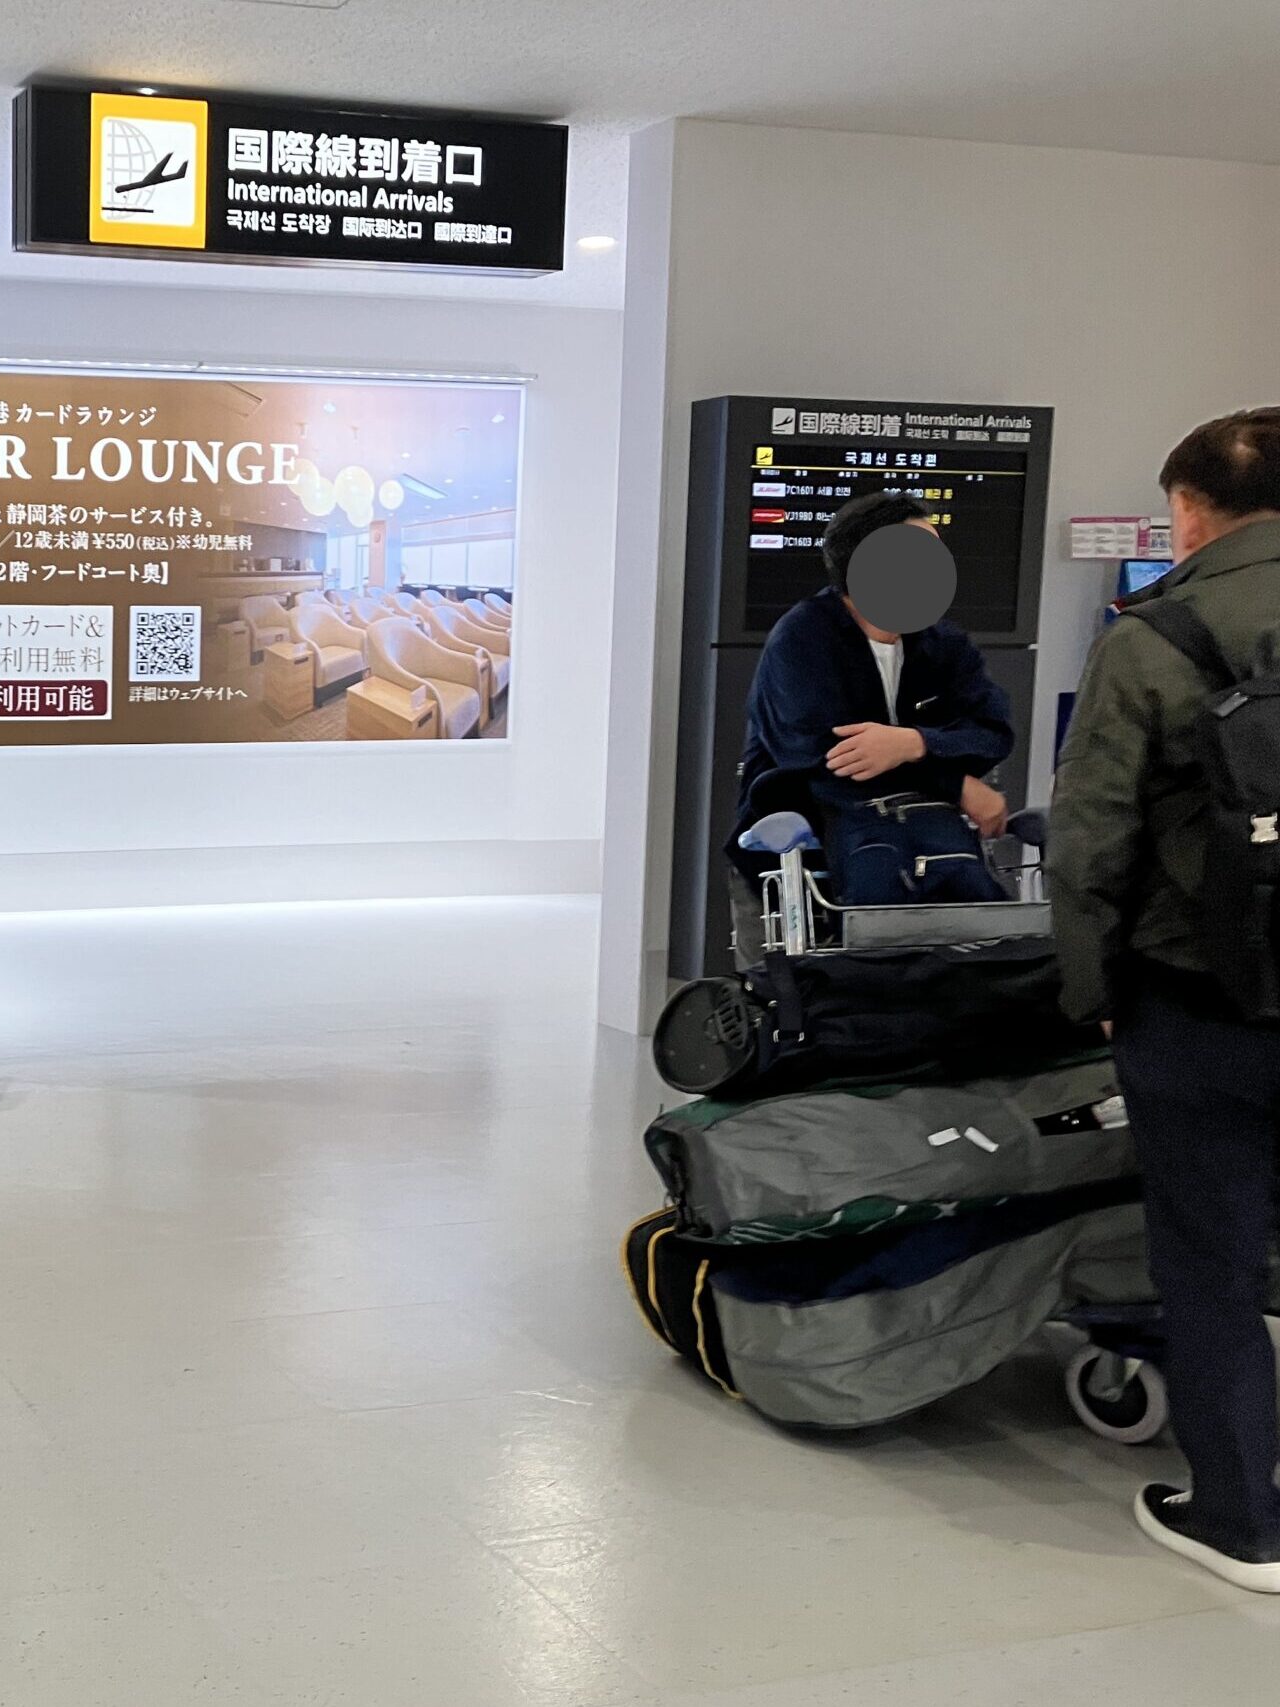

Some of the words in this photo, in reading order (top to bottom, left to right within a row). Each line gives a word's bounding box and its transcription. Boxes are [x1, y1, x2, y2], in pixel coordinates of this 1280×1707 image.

[227, 127, 482, 186] 国際線到着口
[227, 178, 368, 209] International
[372, 187, 454, 213] Arrivals
[226, 209, 276, 232] 국제선
[280, 212, 331, 235] 도착장
[342, 216, 422, 240] 国际到达口
[16, 403, 157, 427] カードラウンジ
[799, 411, 902, 438] 国際線到着
[905, 412, 984, 428] International
[985, 414, 1032, 430] Arrivals
[51, 436, 301, 486] LOUNGE
[845, 451, 887, 466] 국제선
[786, 485, 814, 495] 7C1601
[784, 536, 812, 547] 7C1603
[128, 686, 248, 702] 詳細はウェブサイトへ
